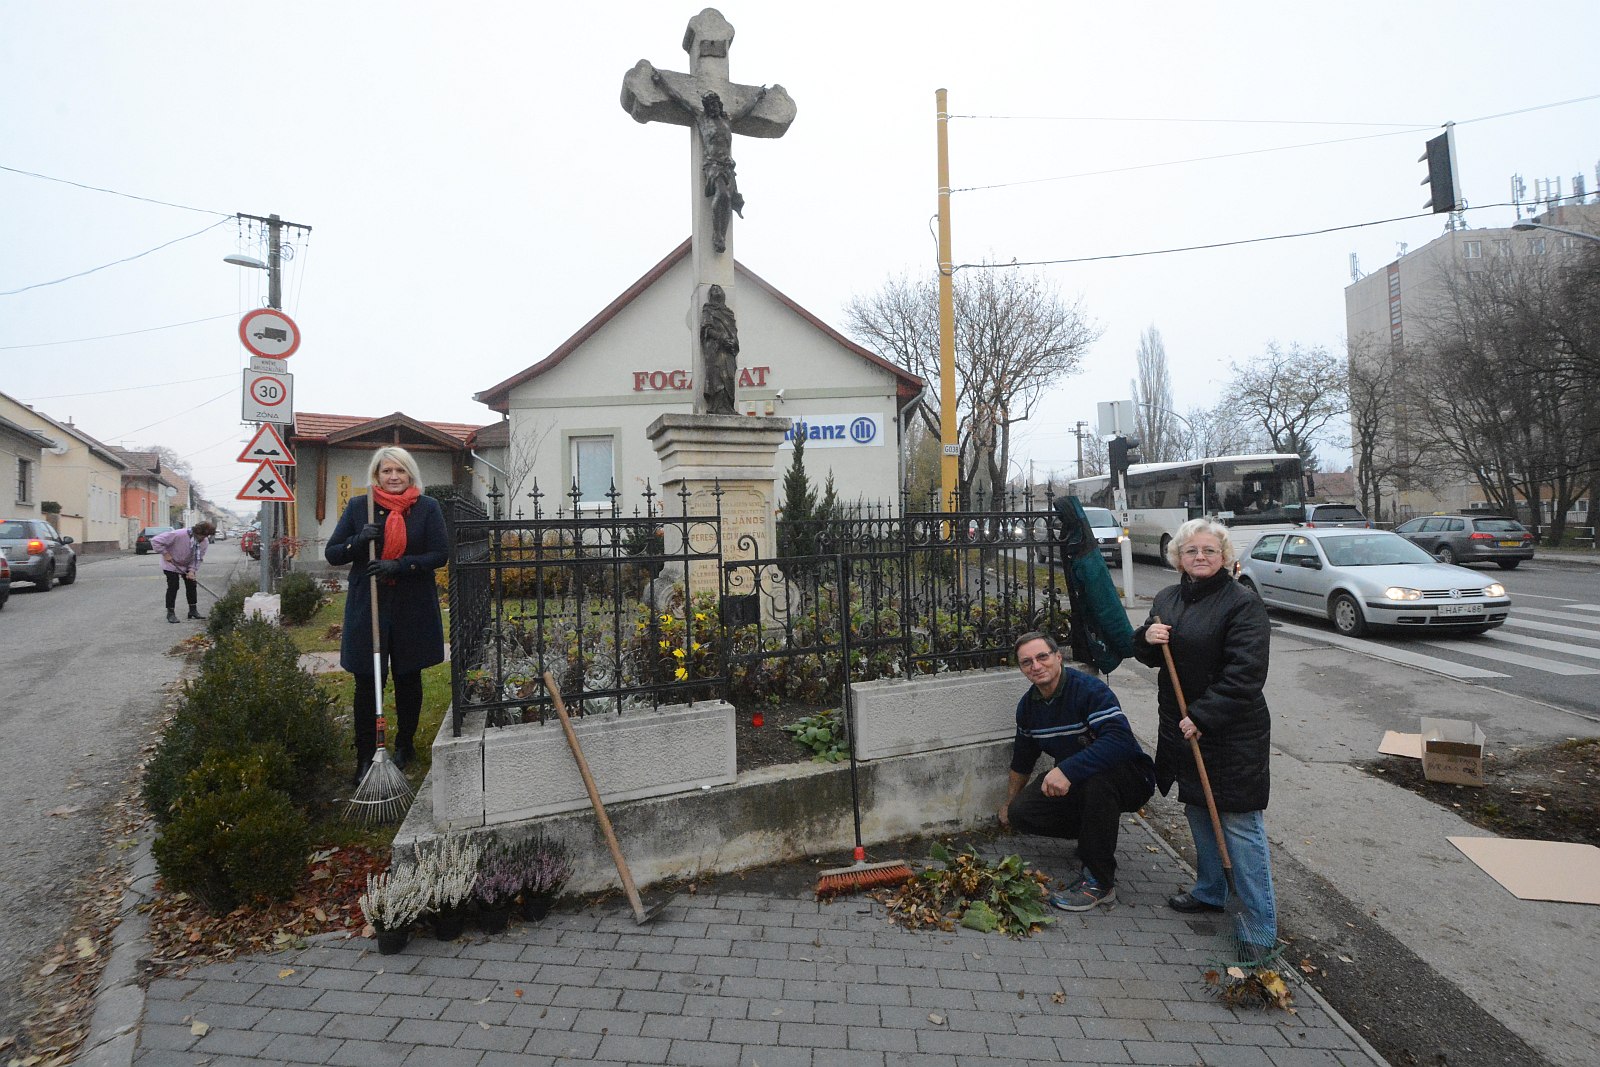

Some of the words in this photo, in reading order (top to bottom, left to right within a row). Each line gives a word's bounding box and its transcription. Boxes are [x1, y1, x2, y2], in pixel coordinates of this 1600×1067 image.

[633, 366, 770, 391] FOGAT
[259, 385, 277, 399] 30
[256, 411, 279, 419] ZÓNA
